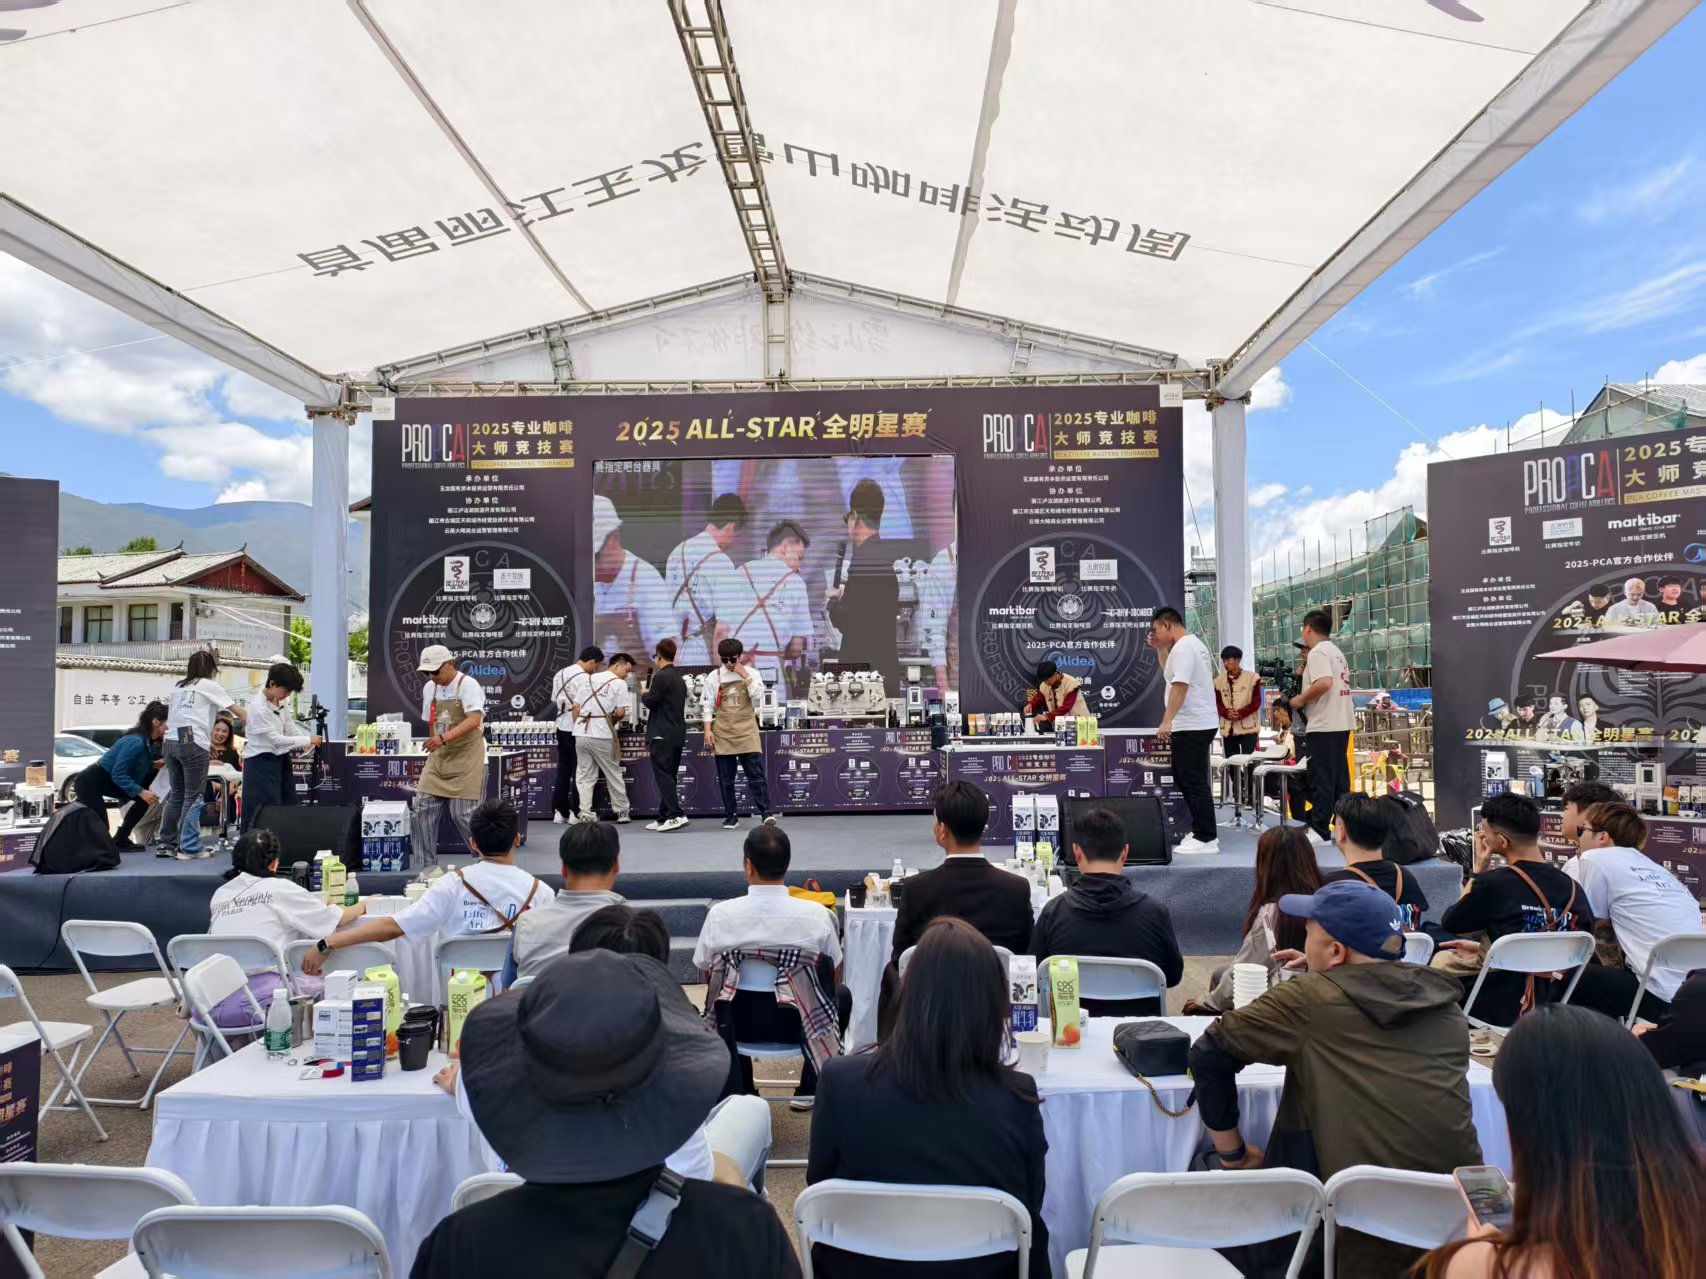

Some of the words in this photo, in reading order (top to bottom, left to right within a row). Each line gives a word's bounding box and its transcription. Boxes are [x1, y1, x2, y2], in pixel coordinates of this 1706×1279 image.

[1054, 410, 1157, 425] 2025专业咖啡
[472, 420, 574, 436] 2025专业咖啡
[615, 419, 680, 442] 2025
[685, 415, 816, 440] ALL-STAR
[822, 412, 928, 439] 全明星赛
[1054, 429, 1158, 446] 大师竞技赛
[472, 439, 574, 456] 大师竞技赛
[1048, 465, 1083, 473] 承办单位
[1049, 487, 1083, 495] 协办单位
[1646, 490, 1680, 500] COFFEE
[1682, 488, 1703, 496] MAS
[1608, 513, 1678, 529] markibar
[1564, 552, 1674, 569] 2025-PCA官方合作伙伴
[989, 605, 1036, 616] markibar
[402, 614, 449, 625] markibar
[1026, 641, 1116, 650] 2025-PCA官方合作伙伴
[449, 650, 527, 658] 25-PCA官方合作伙伴
[1051, 652, 1096, 668] Midea
[463, 662, 506, 676] Midea
[73, 693, 94, 705] 自由
[100, 694, 121, 706] 平等
[127, 695, 147, 706] 公正
[1002, 774, 1037, 782] ALL-STAR
